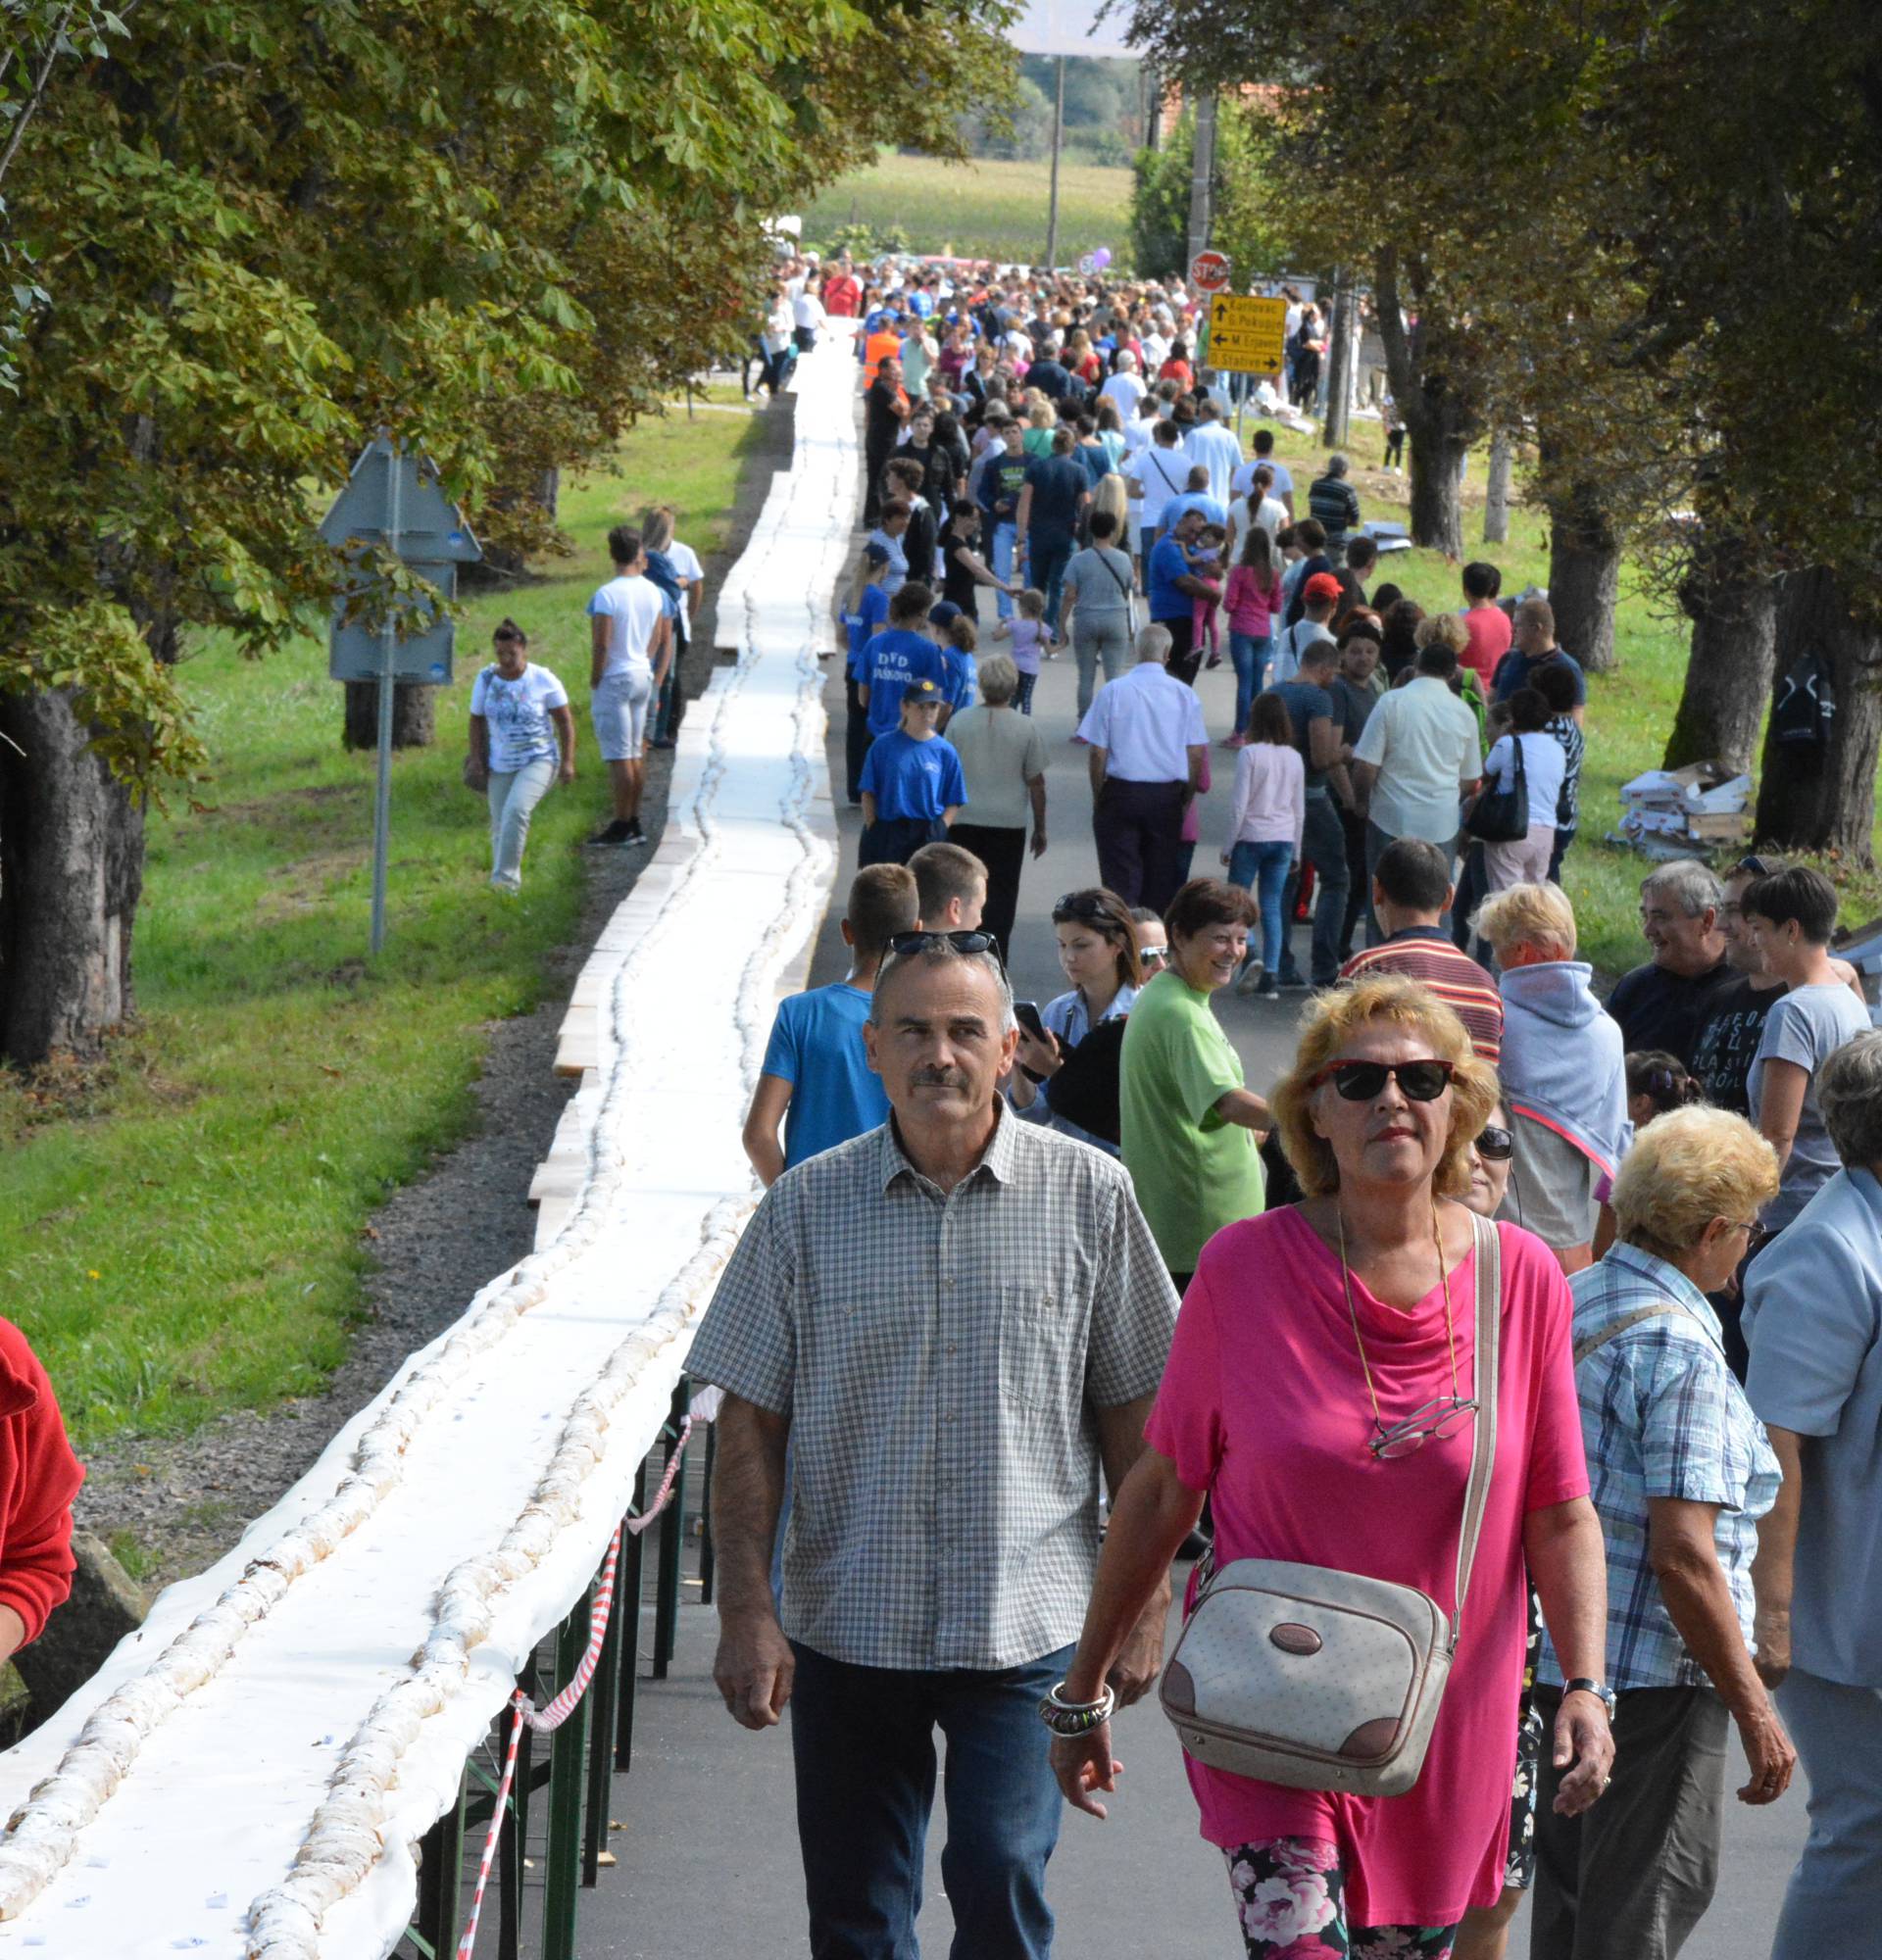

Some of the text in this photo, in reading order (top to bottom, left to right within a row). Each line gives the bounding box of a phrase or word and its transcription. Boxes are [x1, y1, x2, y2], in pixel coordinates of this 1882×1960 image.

[1229, 300, 1278, 315] Karlovac
[1221, 353, 1262, 368] Stative
[878, 652, 909, 667] DVD
